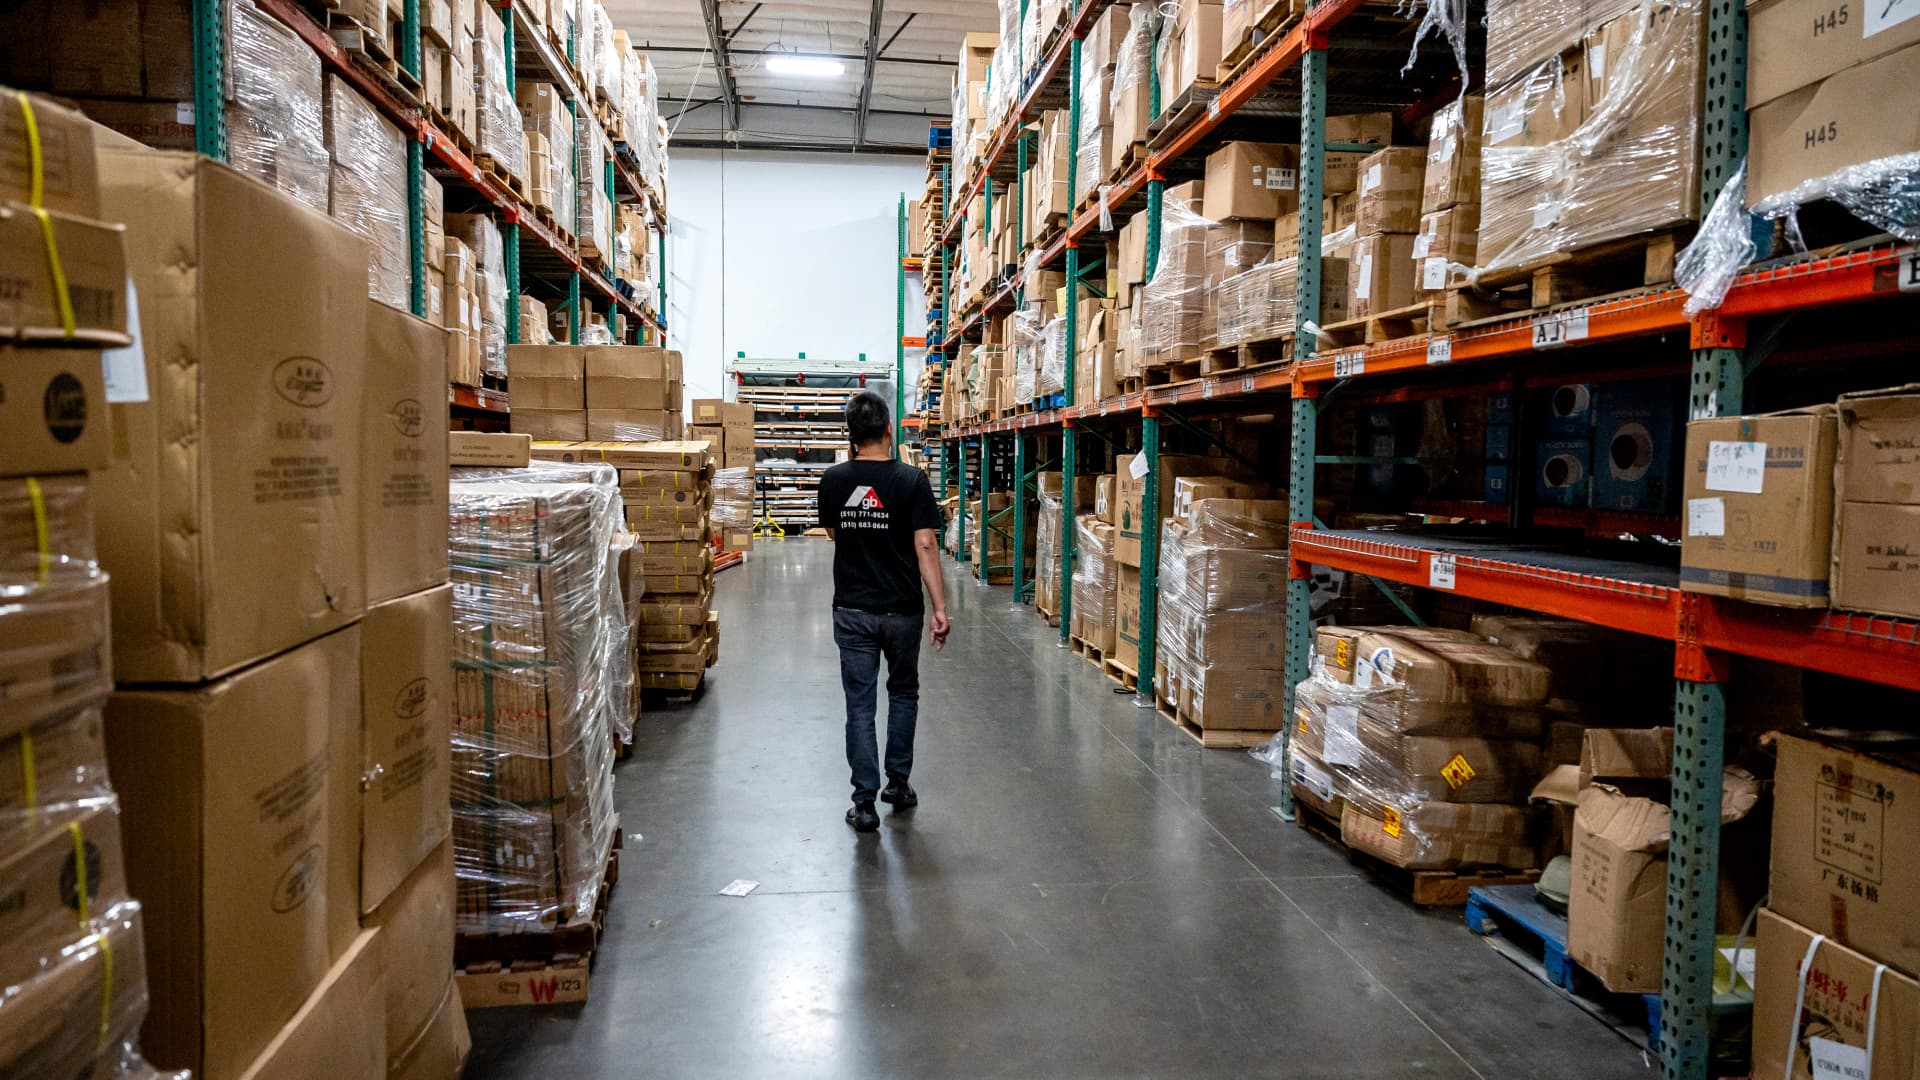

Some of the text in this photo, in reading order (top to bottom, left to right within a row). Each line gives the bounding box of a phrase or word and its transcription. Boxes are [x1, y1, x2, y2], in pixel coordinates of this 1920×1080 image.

[1813, 4, 1849, 38] H45
[1804, 120, 1837, 150] H45
[528, 975, 557, 1003] W
